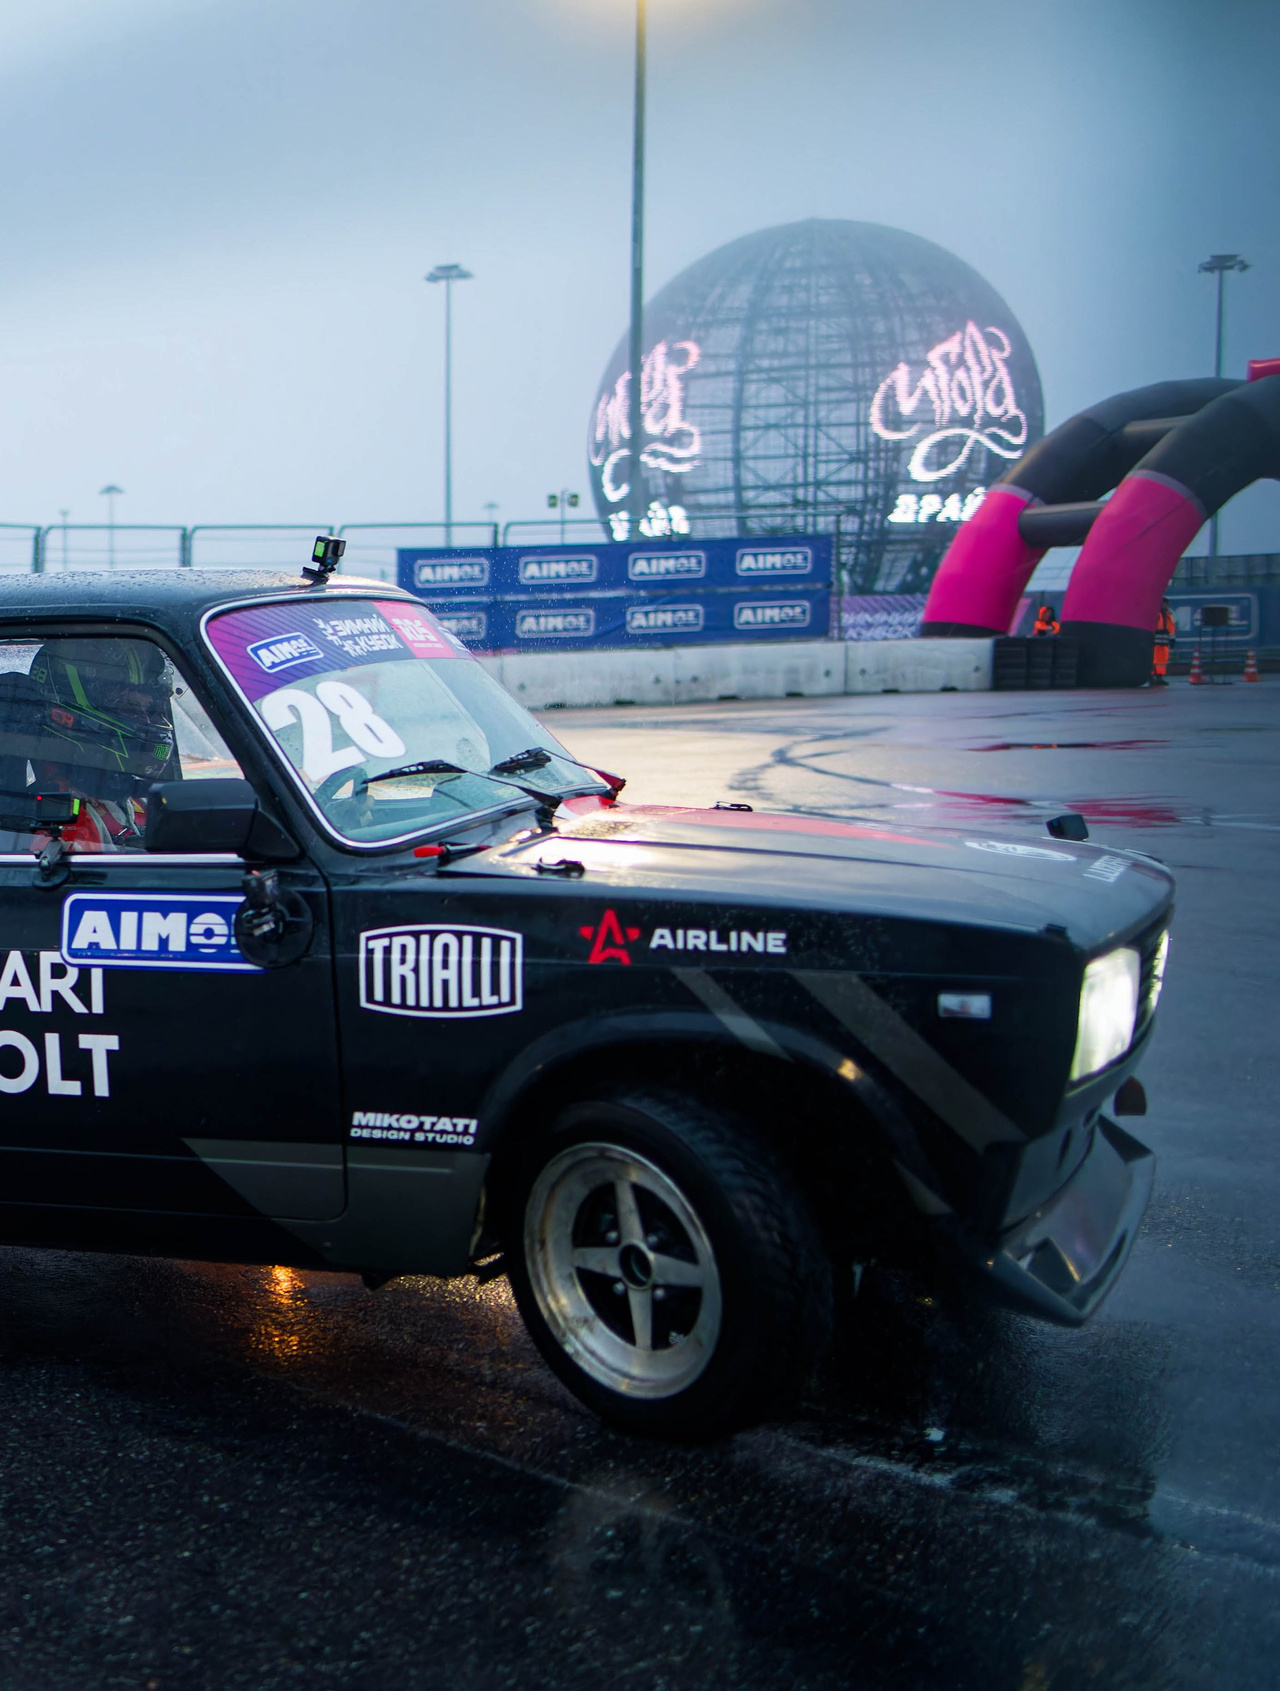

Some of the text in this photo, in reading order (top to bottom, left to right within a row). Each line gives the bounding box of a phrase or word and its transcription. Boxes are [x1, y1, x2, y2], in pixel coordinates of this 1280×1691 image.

[524, 560, 593, 580] AIMOL
[632, 556, 702, 575] AIMOL
[739, 552, 808, 571] AIMOL
[419, 564, 484, 583] AIMOL
[261, 680, 406, 781] 28
[71, 911, 241, 953] AIMO
[649, 927, 787, 954] AIRLINE
[367, 933, 511, 1008] TRIALLI
[352, 1111, 478, 1134] MIKOTATI
[350, 1128, 475, 1145] DESIGN STUDIO
